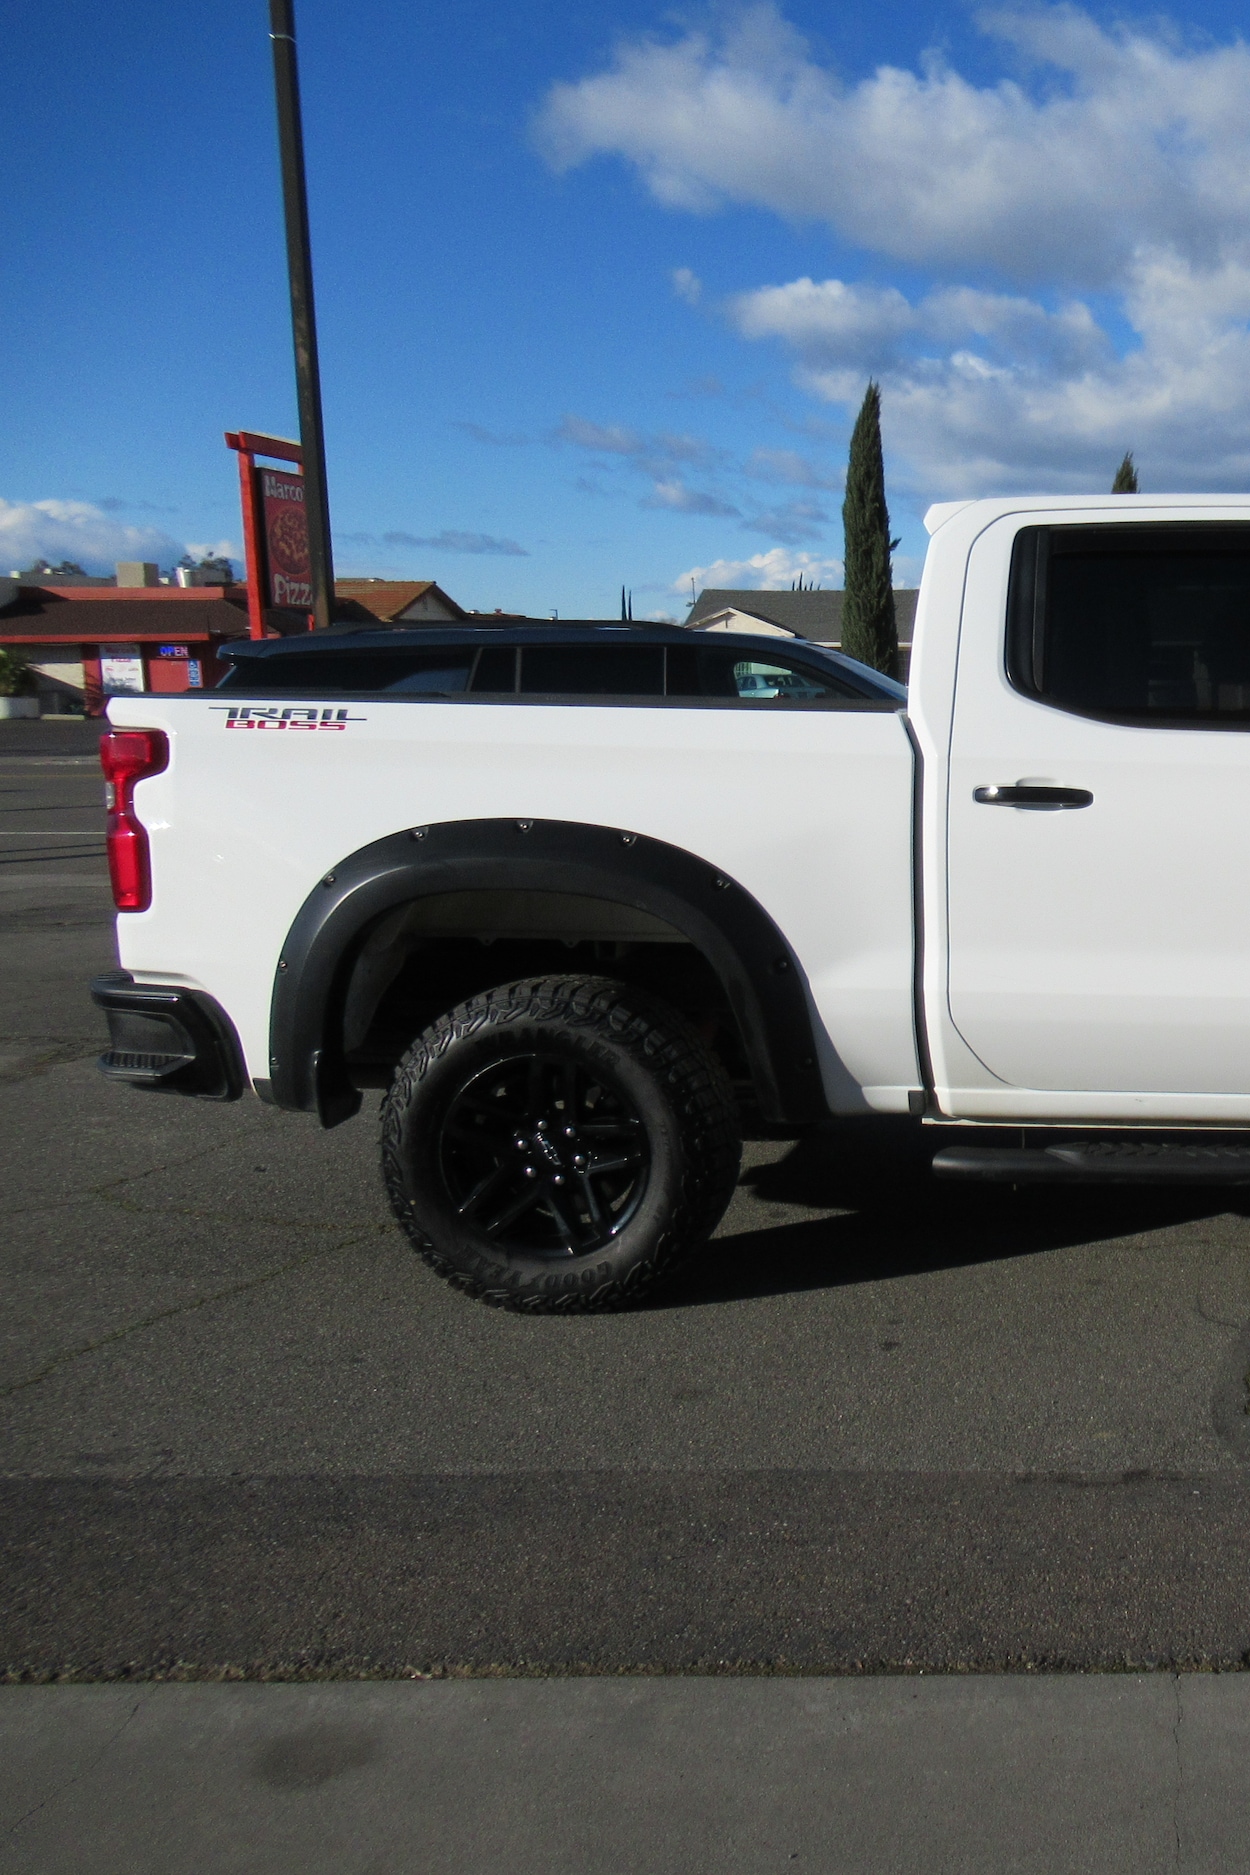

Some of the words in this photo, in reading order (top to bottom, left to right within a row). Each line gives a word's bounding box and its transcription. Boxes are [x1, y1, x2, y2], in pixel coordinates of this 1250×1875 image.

[160, 646, 188, 657] OPEN
[208, 707, 367, 721] TRAIL
[225, 719, 346, 731] BOSS
